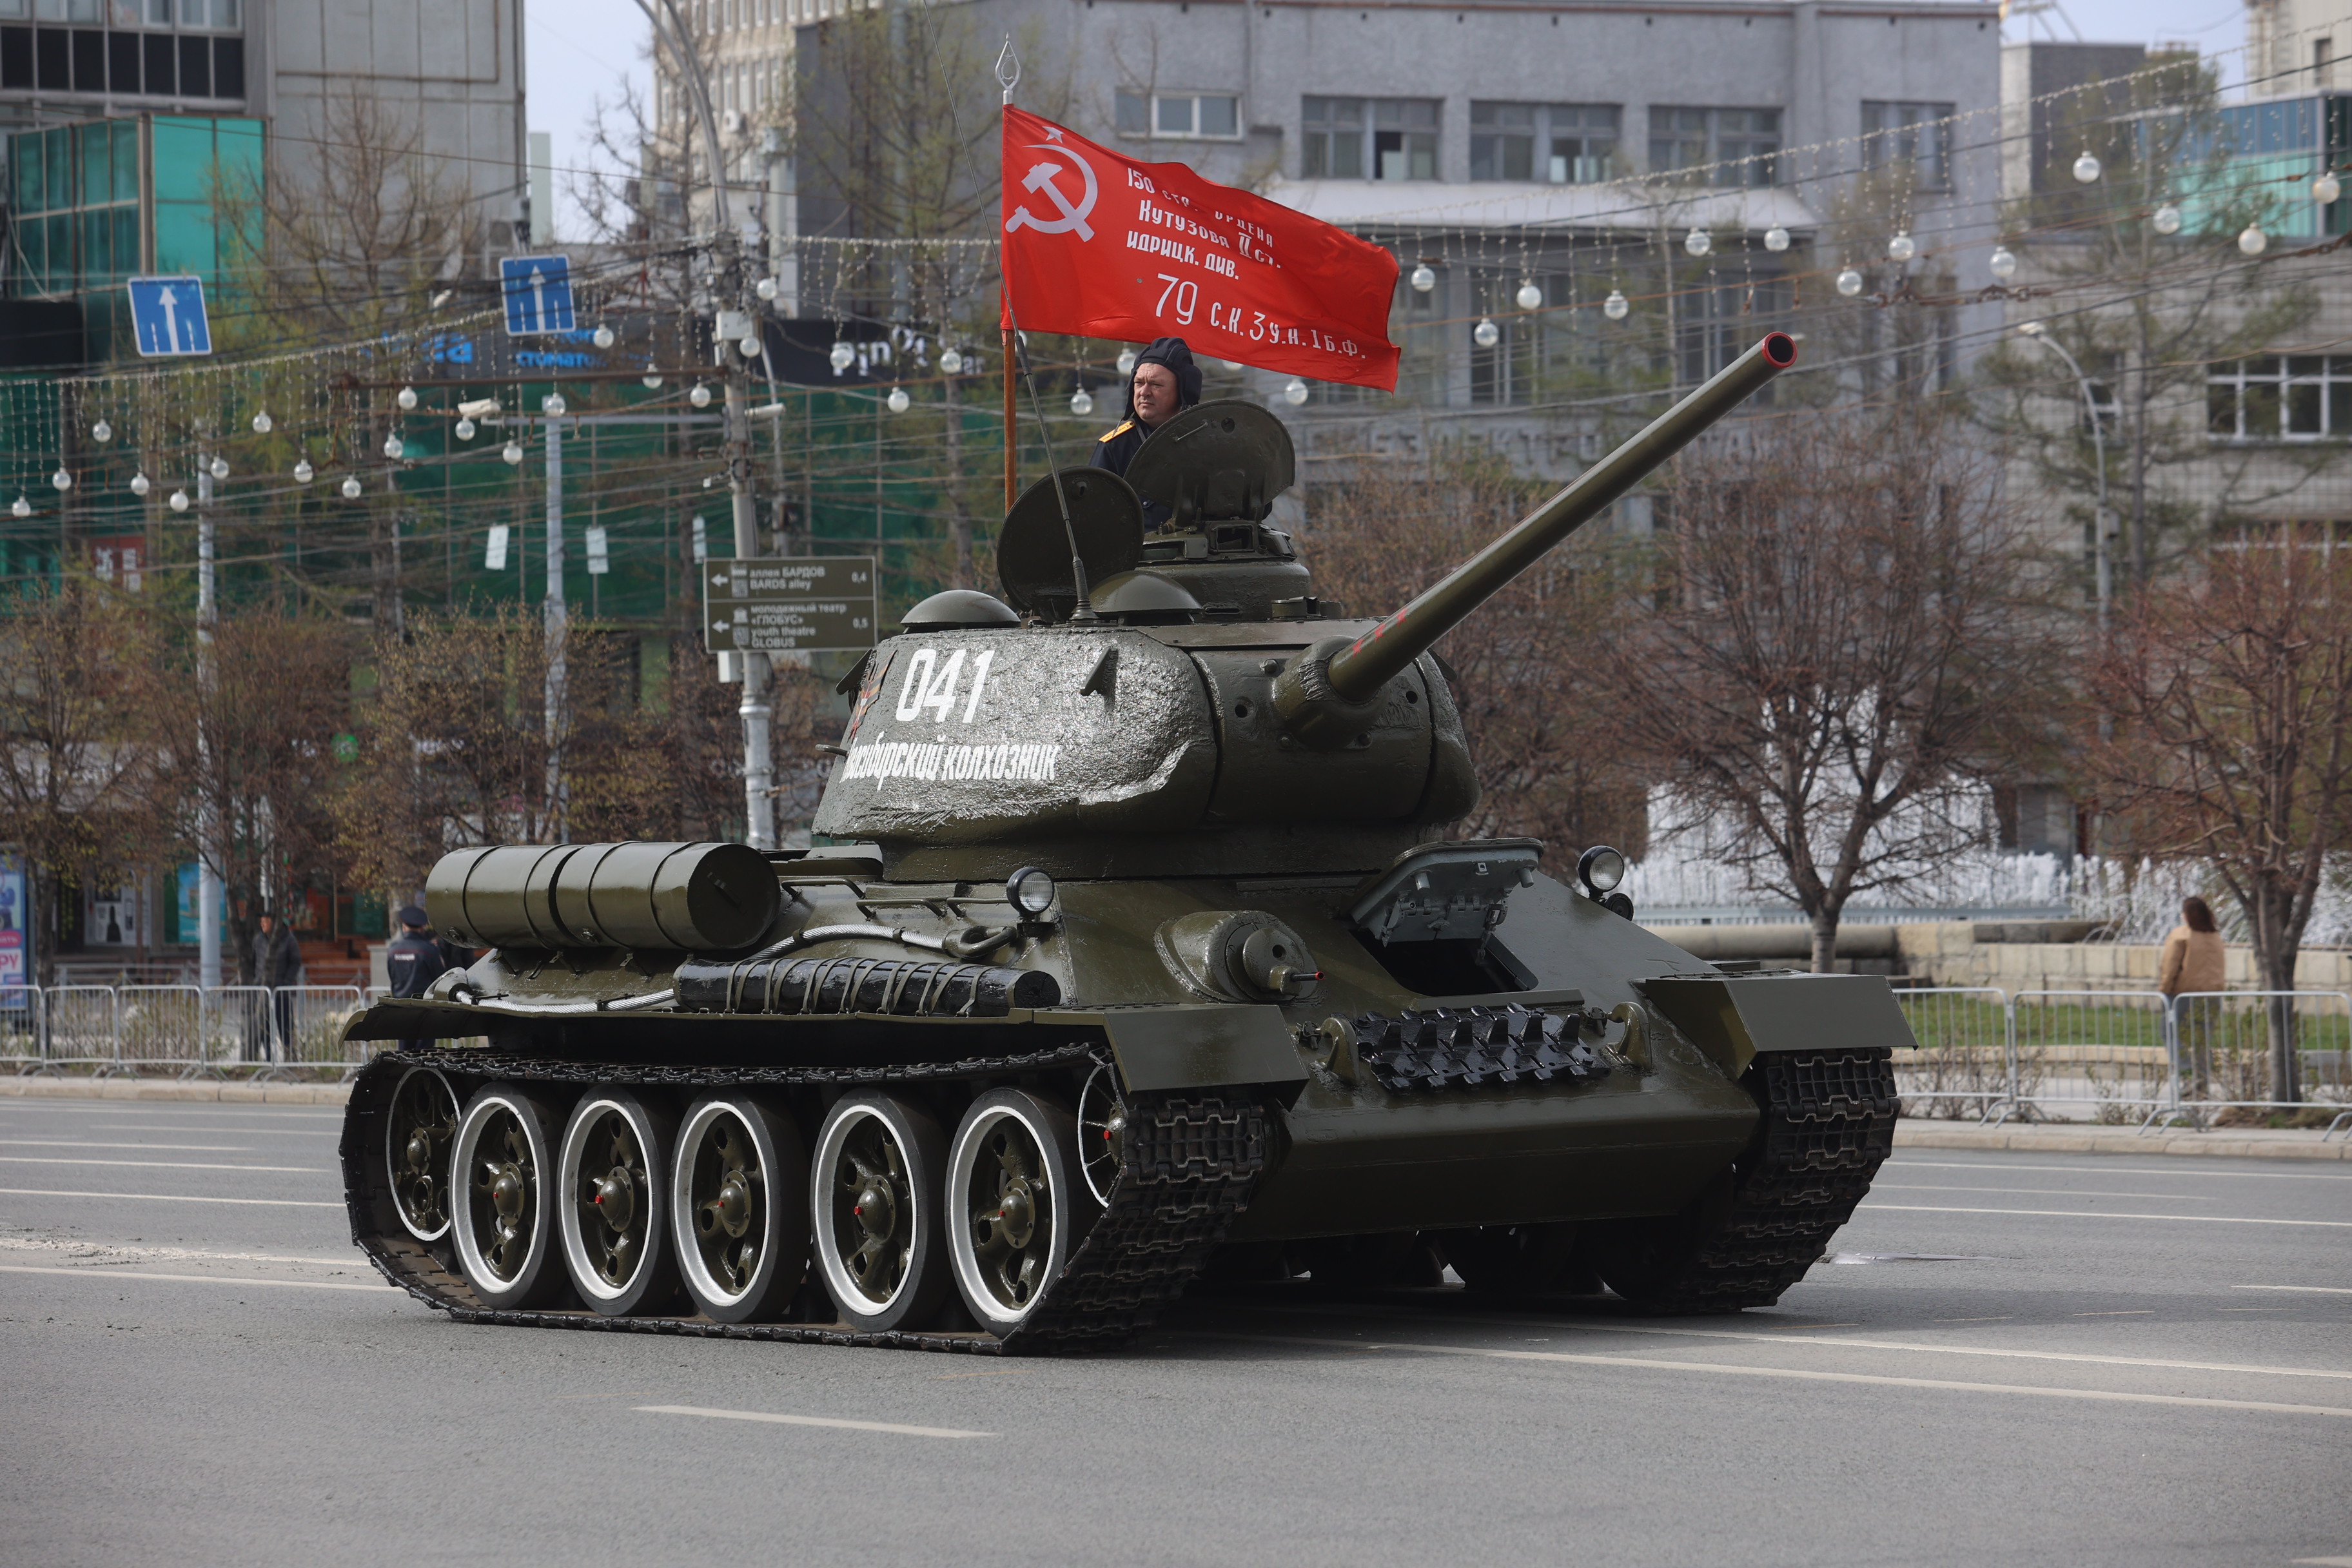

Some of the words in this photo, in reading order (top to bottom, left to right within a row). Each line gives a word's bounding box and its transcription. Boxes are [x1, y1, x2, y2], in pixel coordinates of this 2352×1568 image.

[1128, 168, 1155, 193] 150
[1155, 273, 1198, 325] 79
[782, 567, 825, 578] БАРДОВ
[852, 572, 867, 583] 0,4
[750, 580, 785, 589] BARDS
[788, 580, 812, 591] alley
[818, 603, 847, 614] театр
[853, 618, 868, 629] 0,5
[751, 626, 779, 637] youth
[781, 626, 816, 636] theatre
[752, 637, 796, 648] GLOBUS
[896, 649, 995, 723] 041
